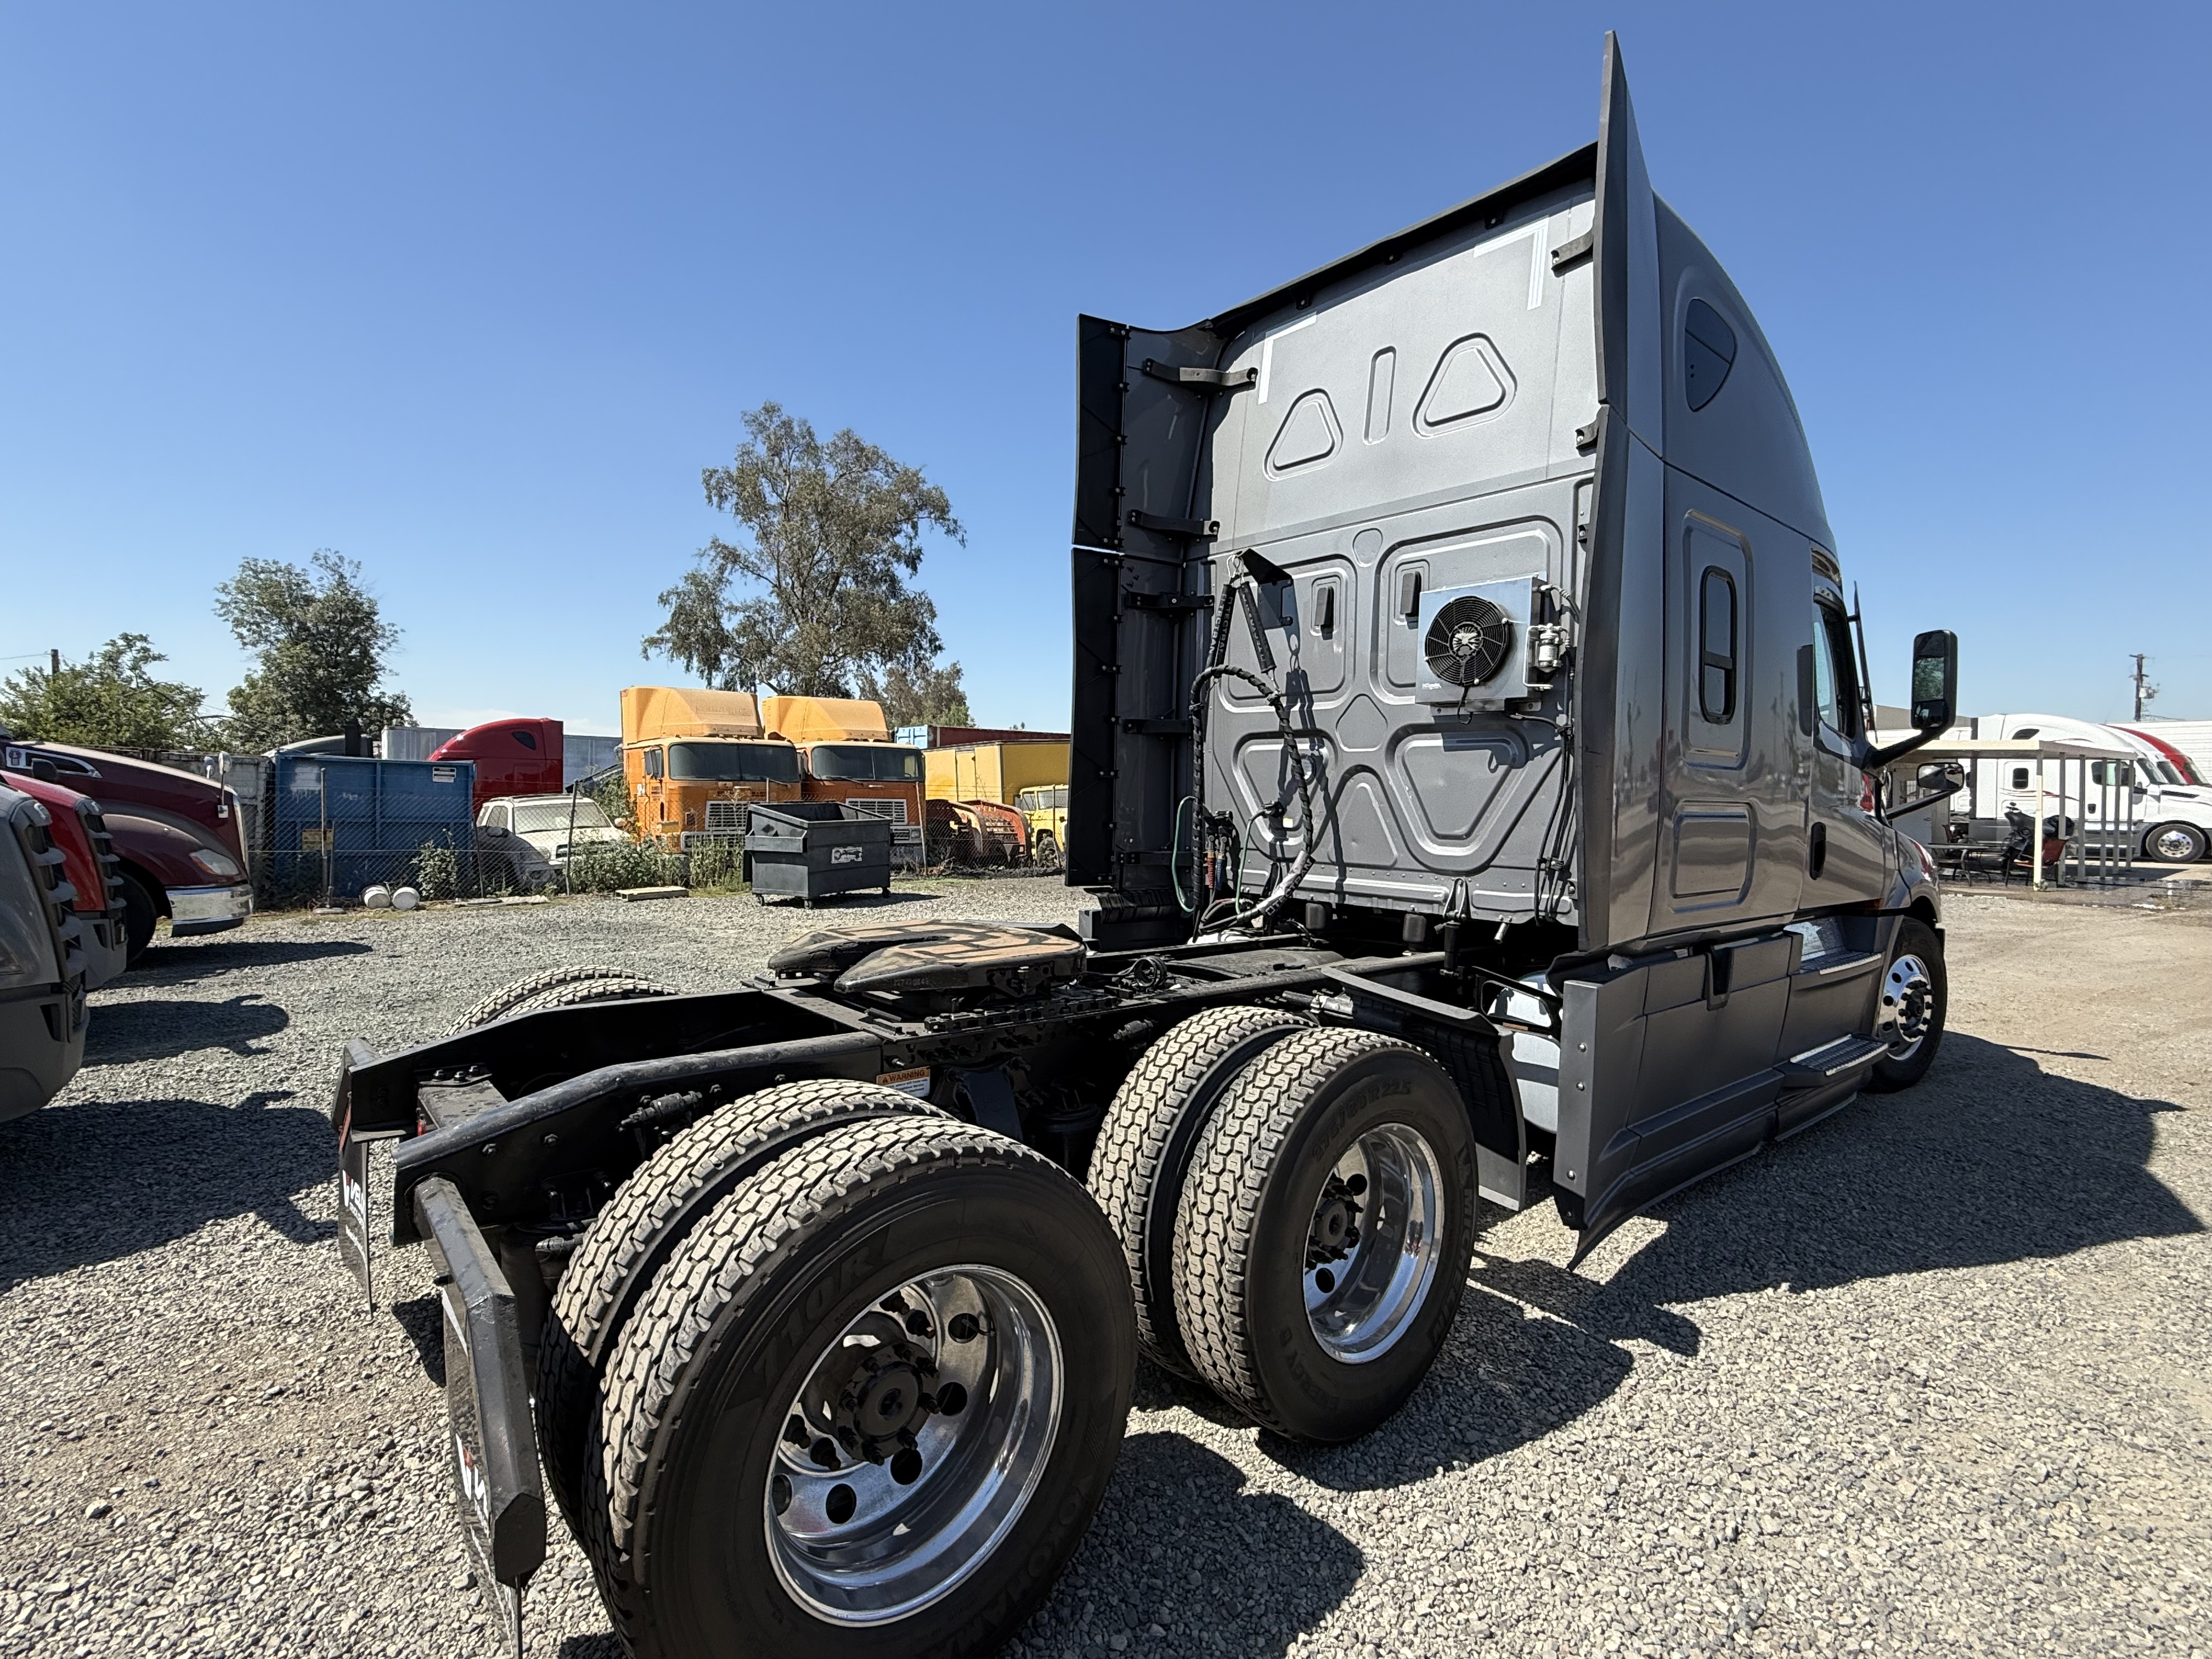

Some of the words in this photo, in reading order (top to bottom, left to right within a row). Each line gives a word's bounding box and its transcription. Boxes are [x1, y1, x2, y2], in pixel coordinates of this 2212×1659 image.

[889, 1070, 924, 1082] WARNING
[753, 1246, 874, 1386] 710R
[1433, 1188, 1473, 1344] MICHELIN
[929, 1474, 1093, 1659] YOKOHAMA
